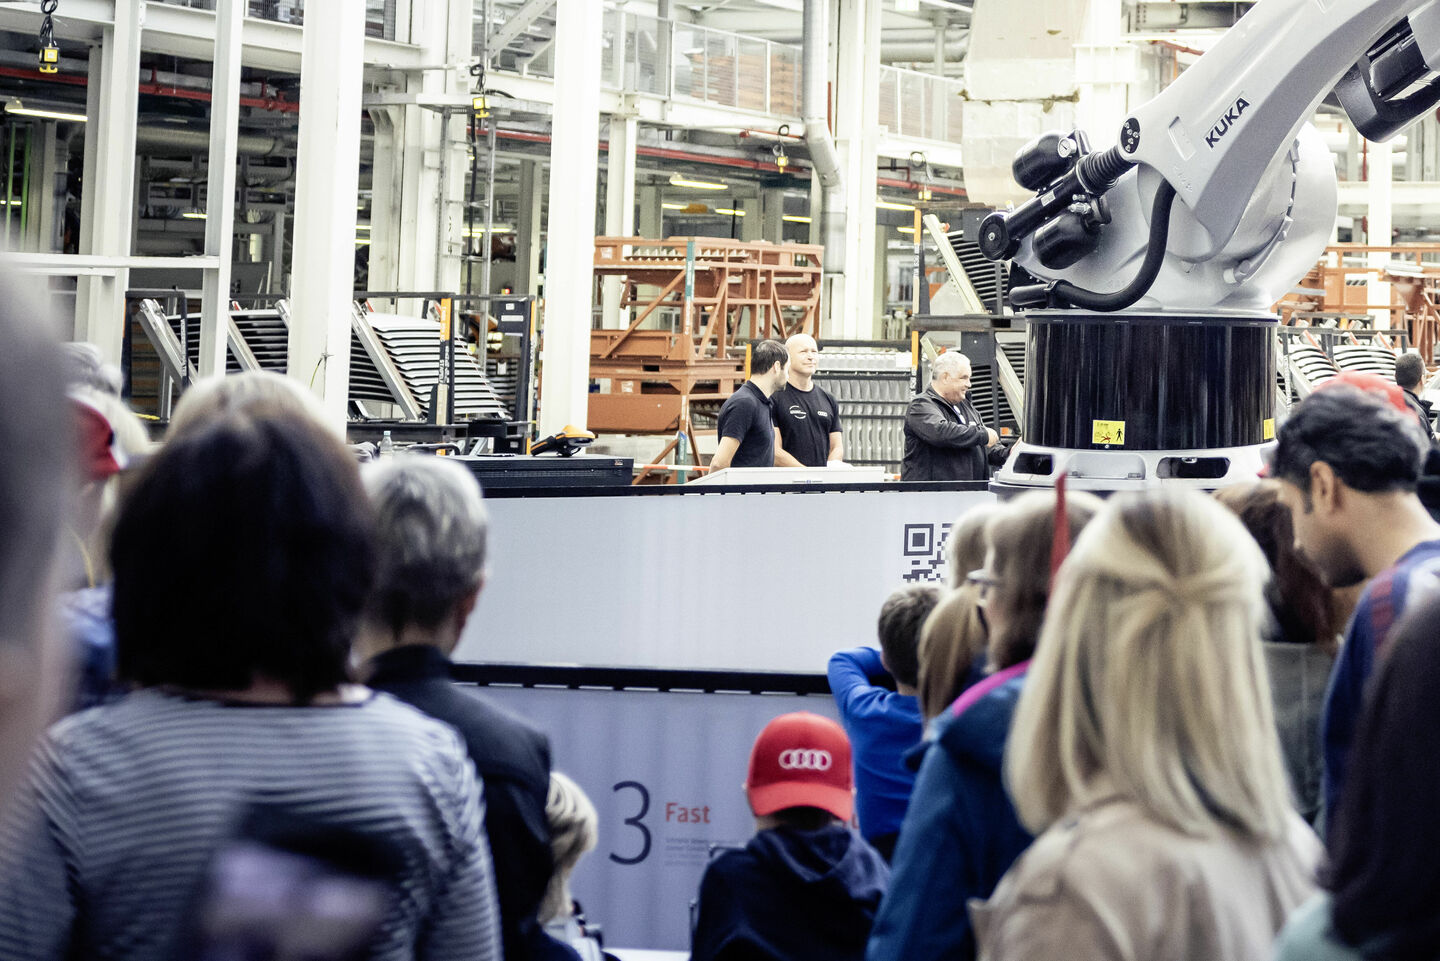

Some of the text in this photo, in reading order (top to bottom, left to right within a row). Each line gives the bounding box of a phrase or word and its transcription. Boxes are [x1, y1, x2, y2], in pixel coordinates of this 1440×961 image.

[1205, 97, 1250, 149] KUKA
[608, 780, 652, 865] 3
[665, 802, 711, 824] Fast
